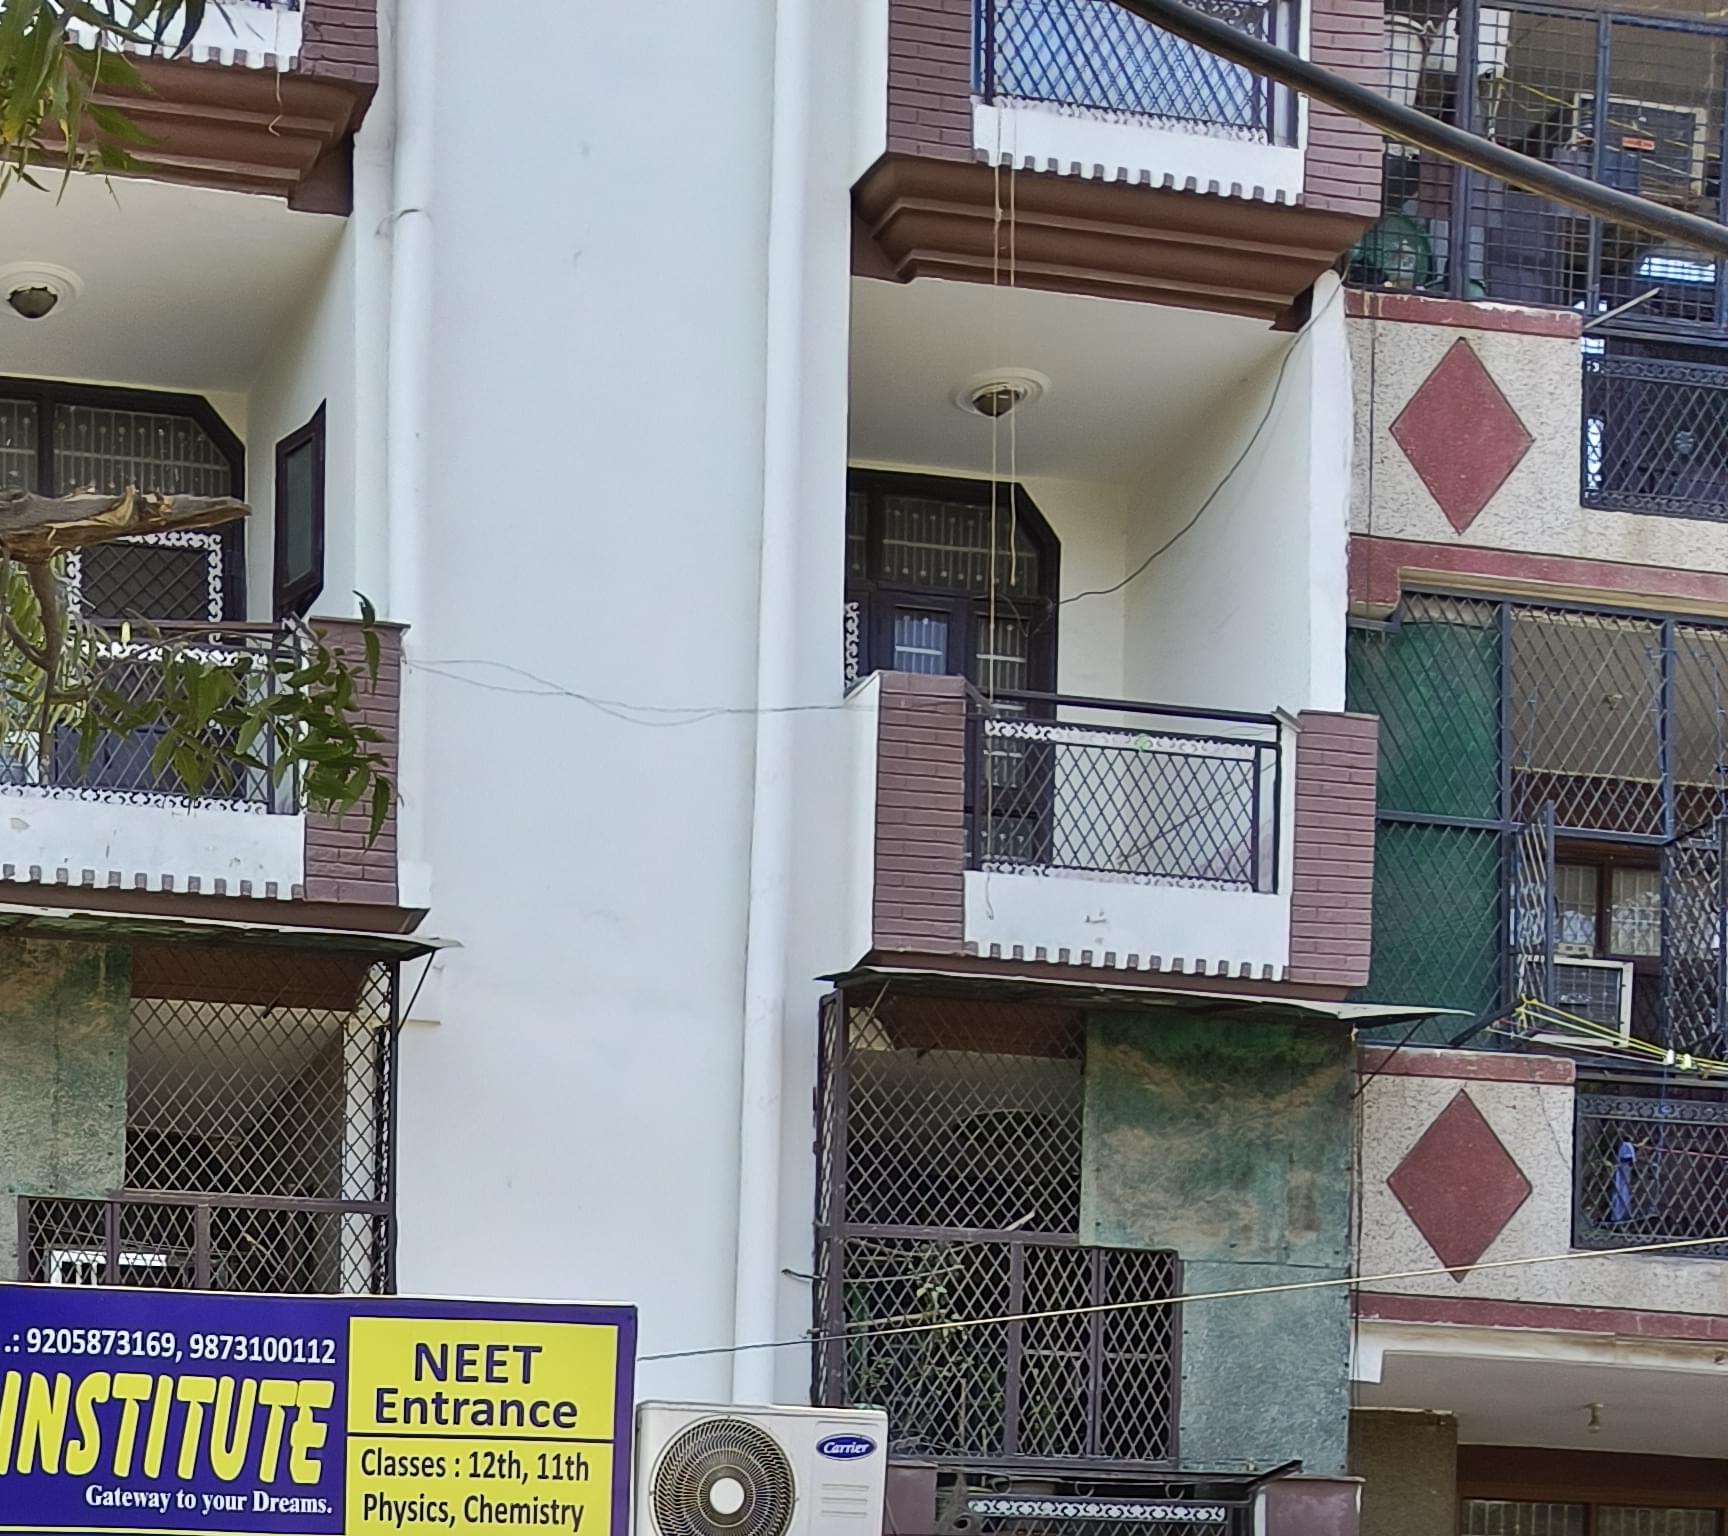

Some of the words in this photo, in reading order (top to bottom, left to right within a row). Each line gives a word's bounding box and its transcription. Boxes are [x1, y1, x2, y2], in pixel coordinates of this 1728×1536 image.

[26, 1327, 183, 1364] 9205873169,
[189, 1333, 336, 1366] 9873100112
[413, 1342, 542, 1385] NEET
[375, 1387, 579, 1429] Entrance
[822, 1439, 871, 1456] Carrier
[361, 1450, 446, 1480] Classes
[468, 1451, 529, 1485] 12th,
[536, 1452, 590, 1483] 11th
[86, 1485, 171, 1514] Gateway
[176, 1489, 198, 1511] to
[202, 1492, 247, 1515] your
[253, 1490, 333, 1515] Dreams.
[363, 1494, 457, 1529] Physics,
[463, 1496, 585, 1532] Chemistry
